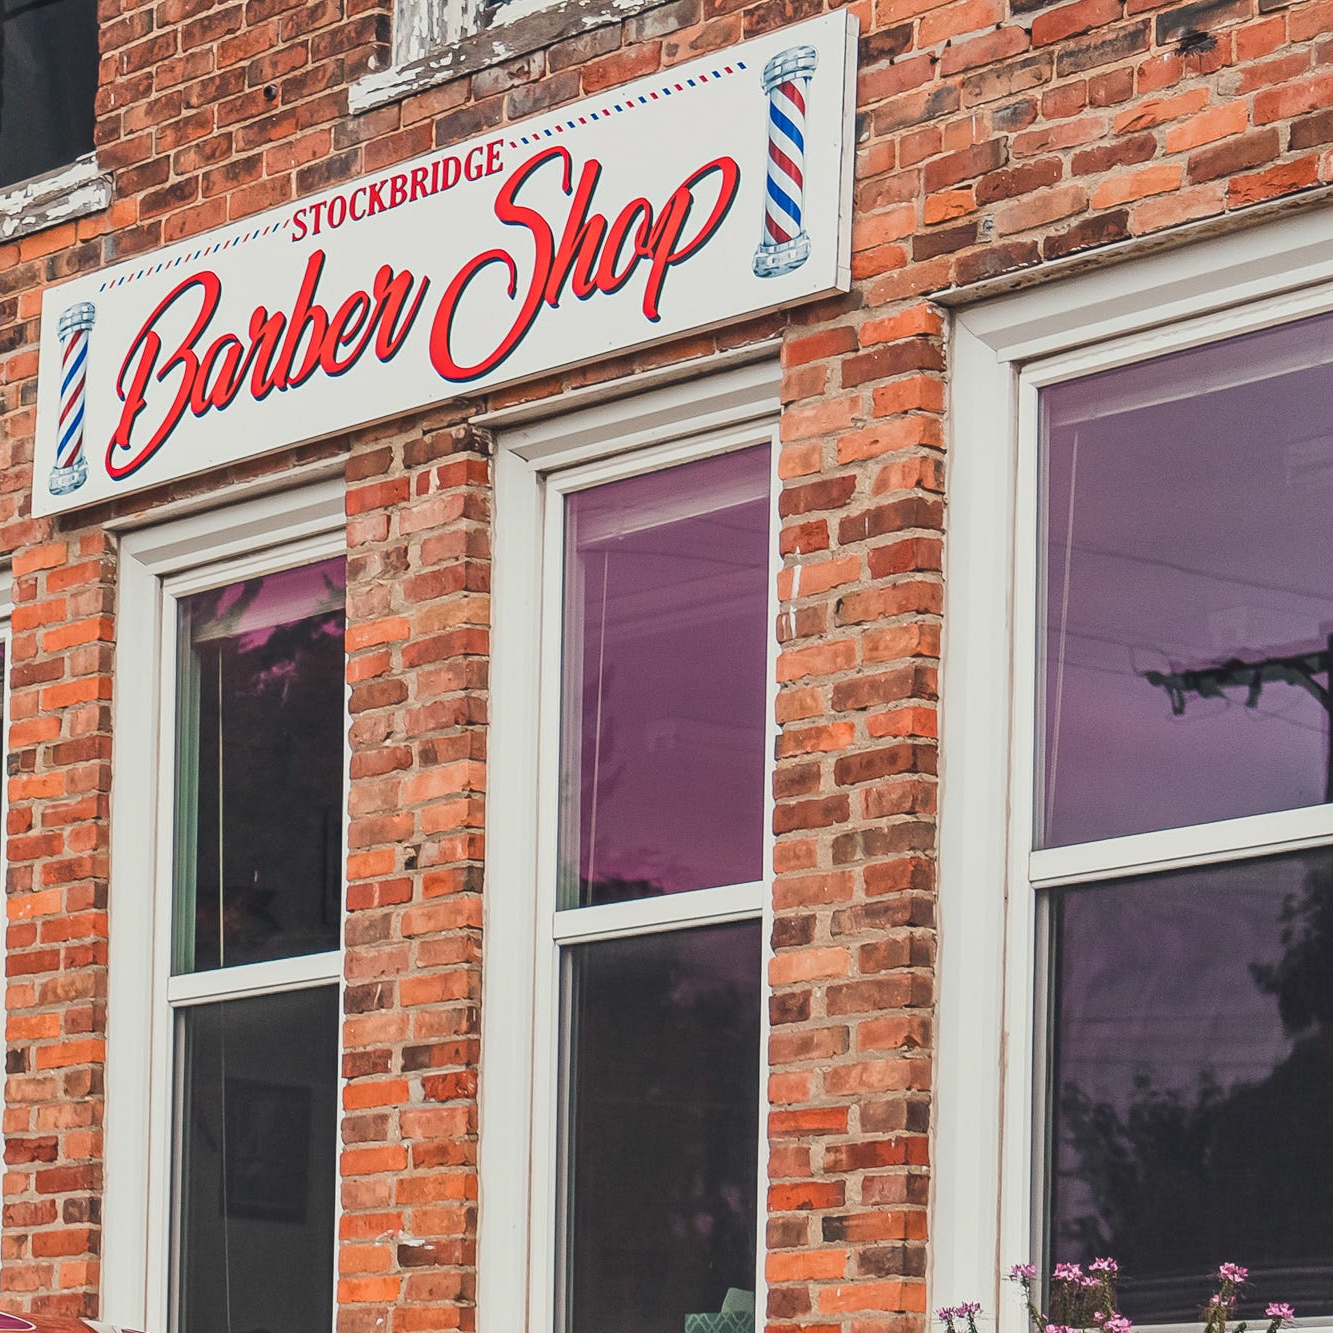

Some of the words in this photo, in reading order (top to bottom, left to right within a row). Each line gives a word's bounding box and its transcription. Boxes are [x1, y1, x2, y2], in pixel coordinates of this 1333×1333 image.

[291, 138, 505, 243] STOCKBRIDGE
[104, 249, 431, 482] Barber
[428, 145, 741, 385] Shop
